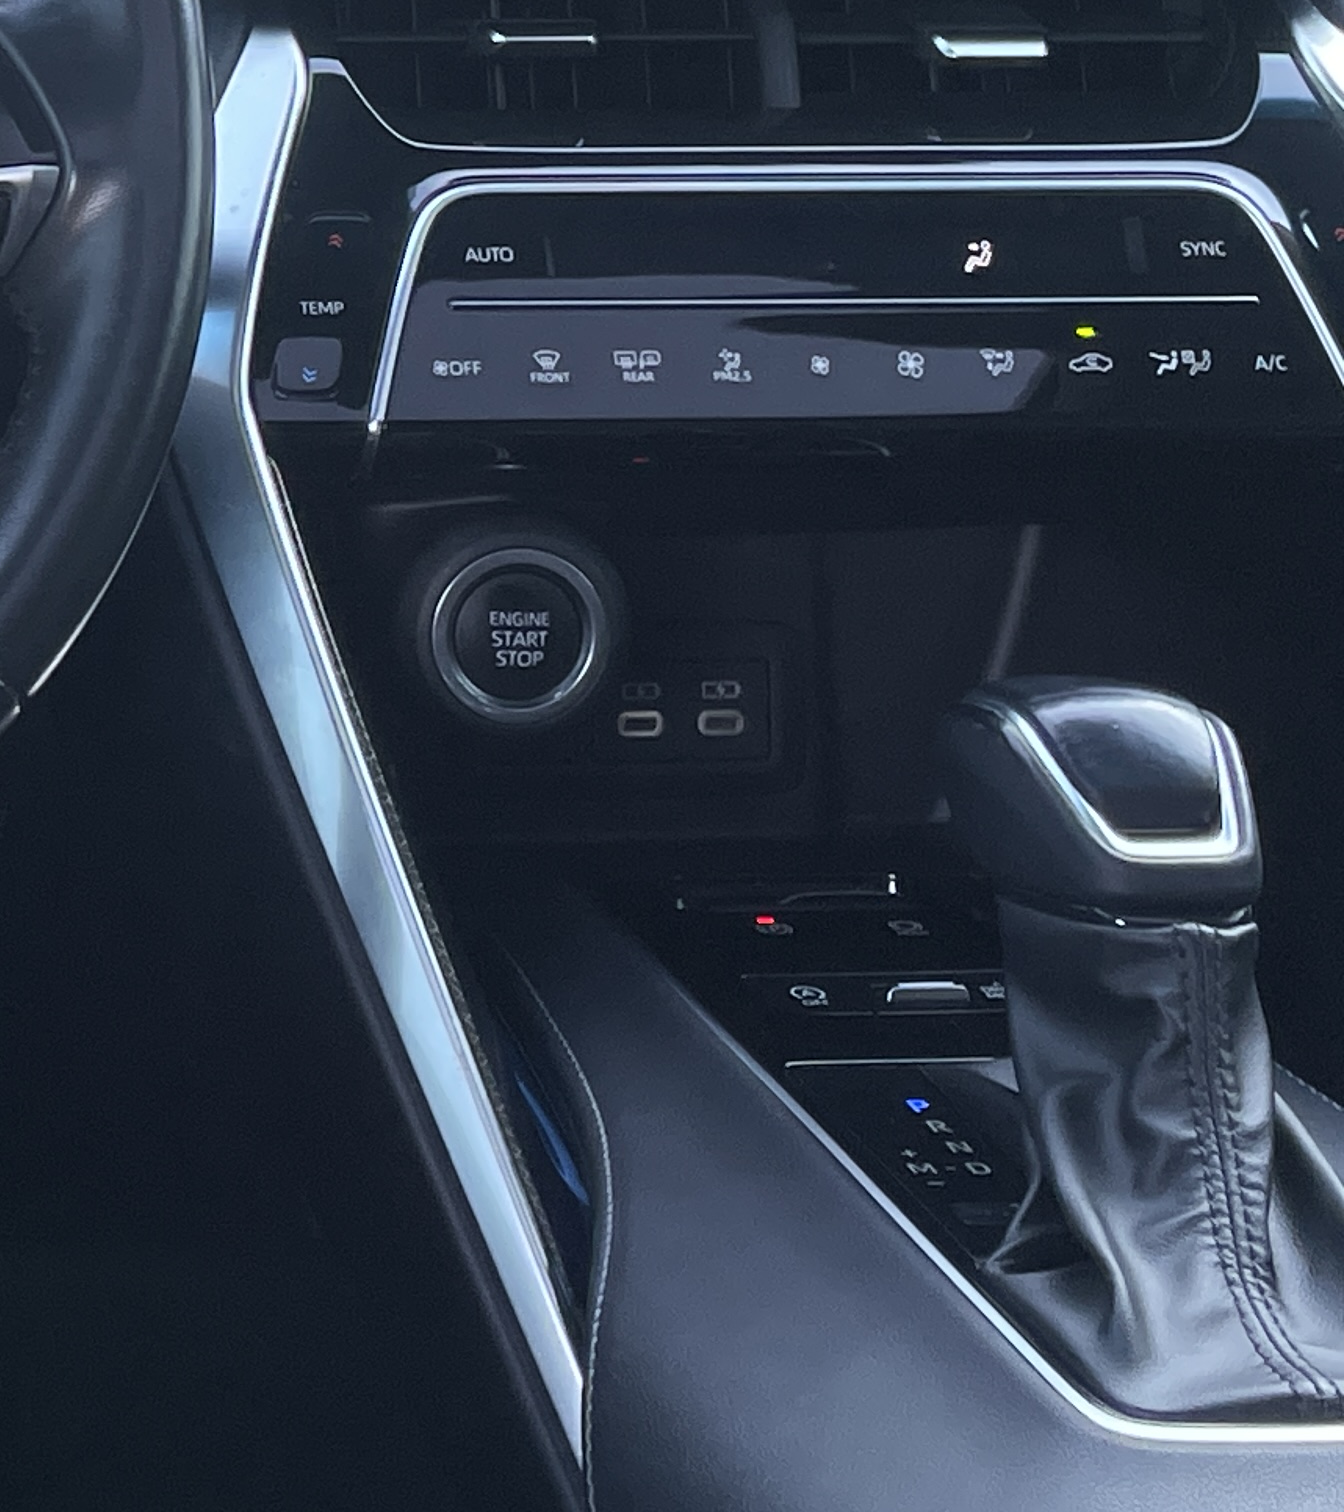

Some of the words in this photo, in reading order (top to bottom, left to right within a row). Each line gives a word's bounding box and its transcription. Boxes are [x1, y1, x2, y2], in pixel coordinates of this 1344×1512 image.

[465, 246, 514, 263] AUTO
[1179, 241, 1227, 258] SYNC
[299, 300, 345, 316] TEMP
[449, 360, 482, 377] OFF
[1254, 354, 1288, 373] A/C
[529, 371, 570, 384] FRONT
[622, 370, 655, 384] REAR
[712, 371, 752, 384] PM2.5
[489, 611, 550, 627] ENGINE
[491, 631, 548, 648] START
[495, 650, 544, 668] STOP
[906, 1098, 930, 1113] P
[926, 1120, 953, 1134] R
[946, 1141, 972, 1154] N
[906, 1161, 939, 1175] M
[964, 1161, 993, 1176] D
